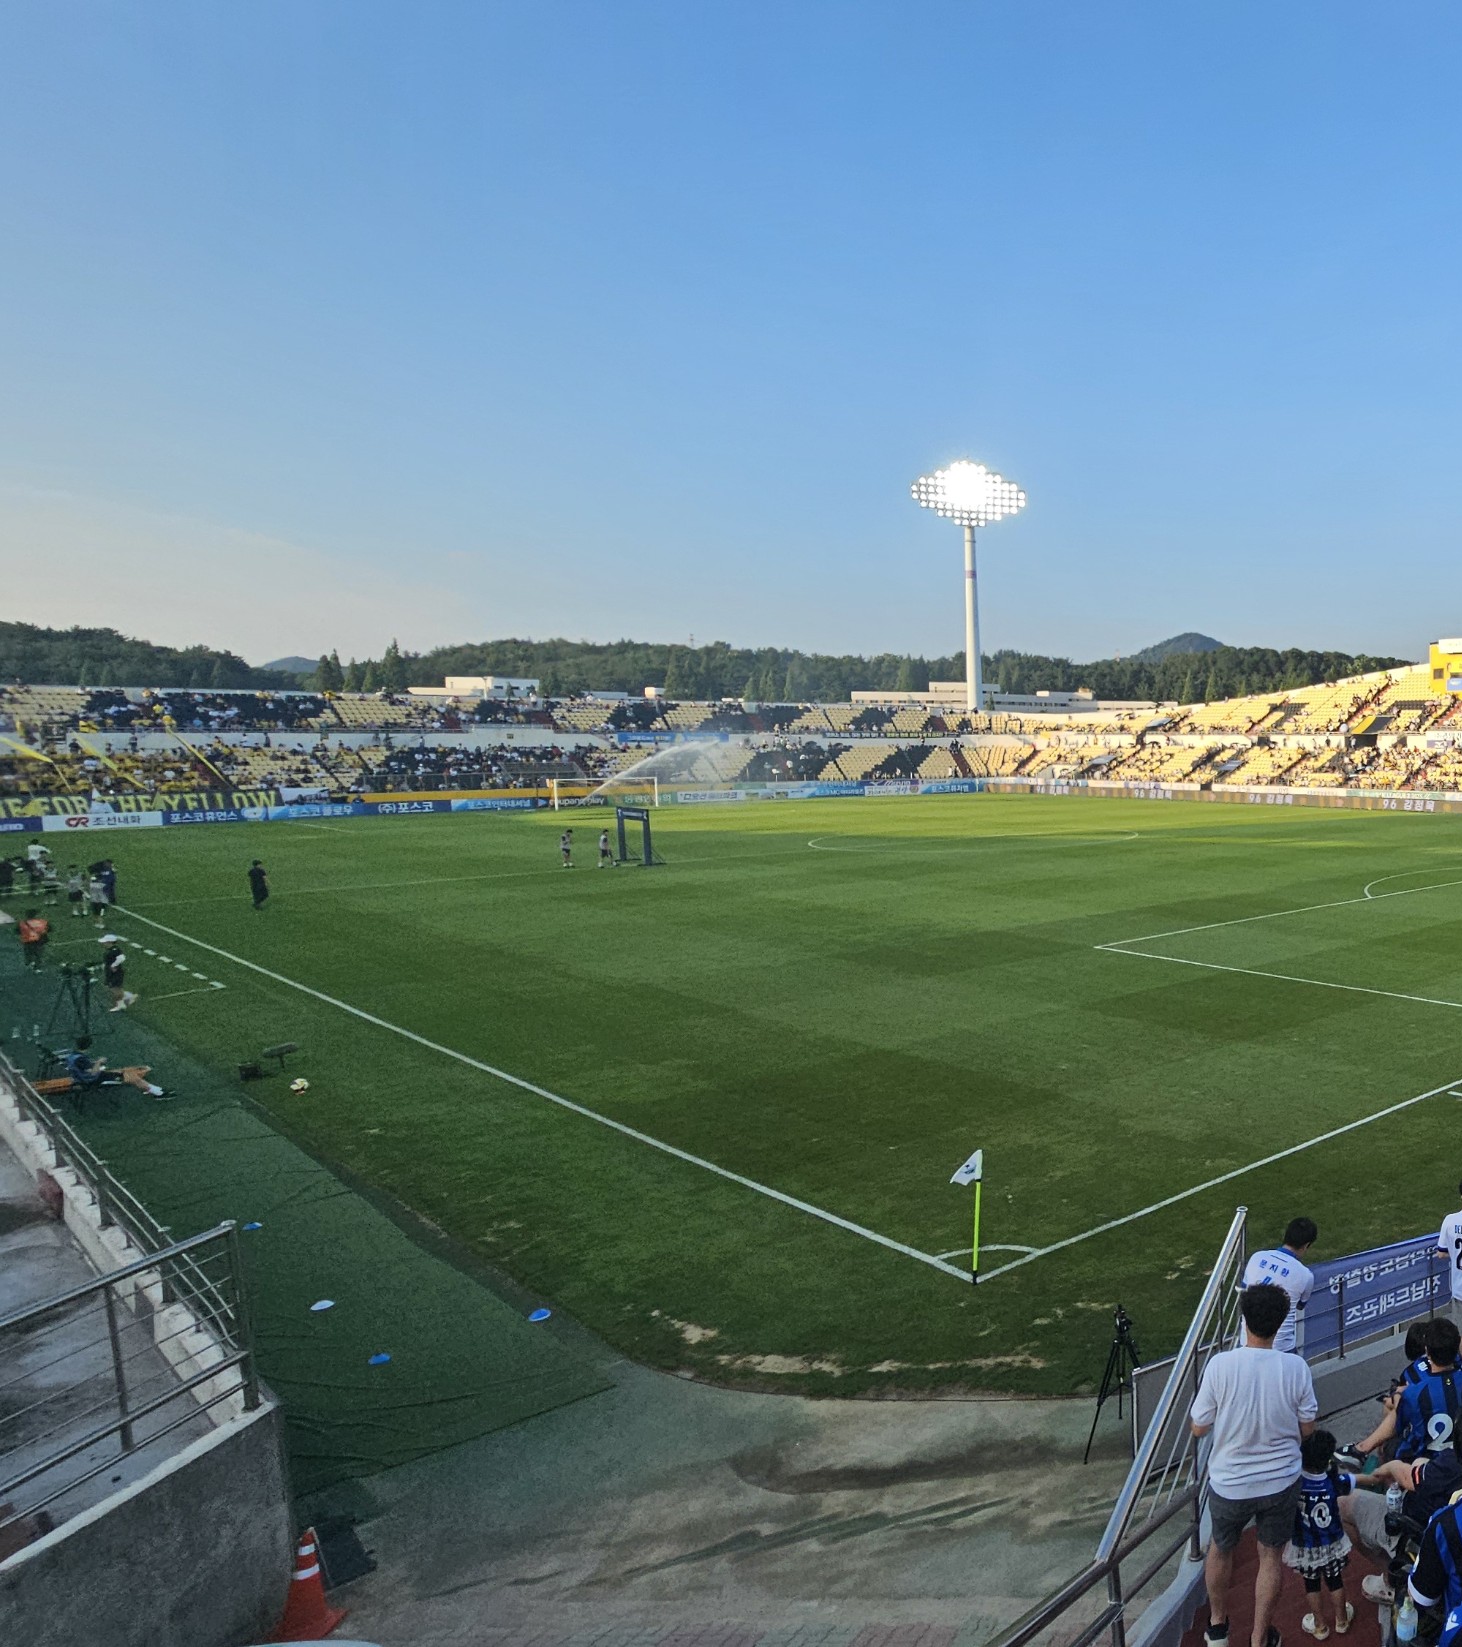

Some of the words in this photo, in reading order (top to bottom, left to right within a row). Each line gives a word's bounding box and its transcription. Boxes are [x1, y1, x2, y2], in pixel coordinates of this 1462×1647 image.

[162, 790, 277, 811] YELLOW
[1383, 799, 1397, 809] 96
[92, 815, 141, 826] 조선내화
